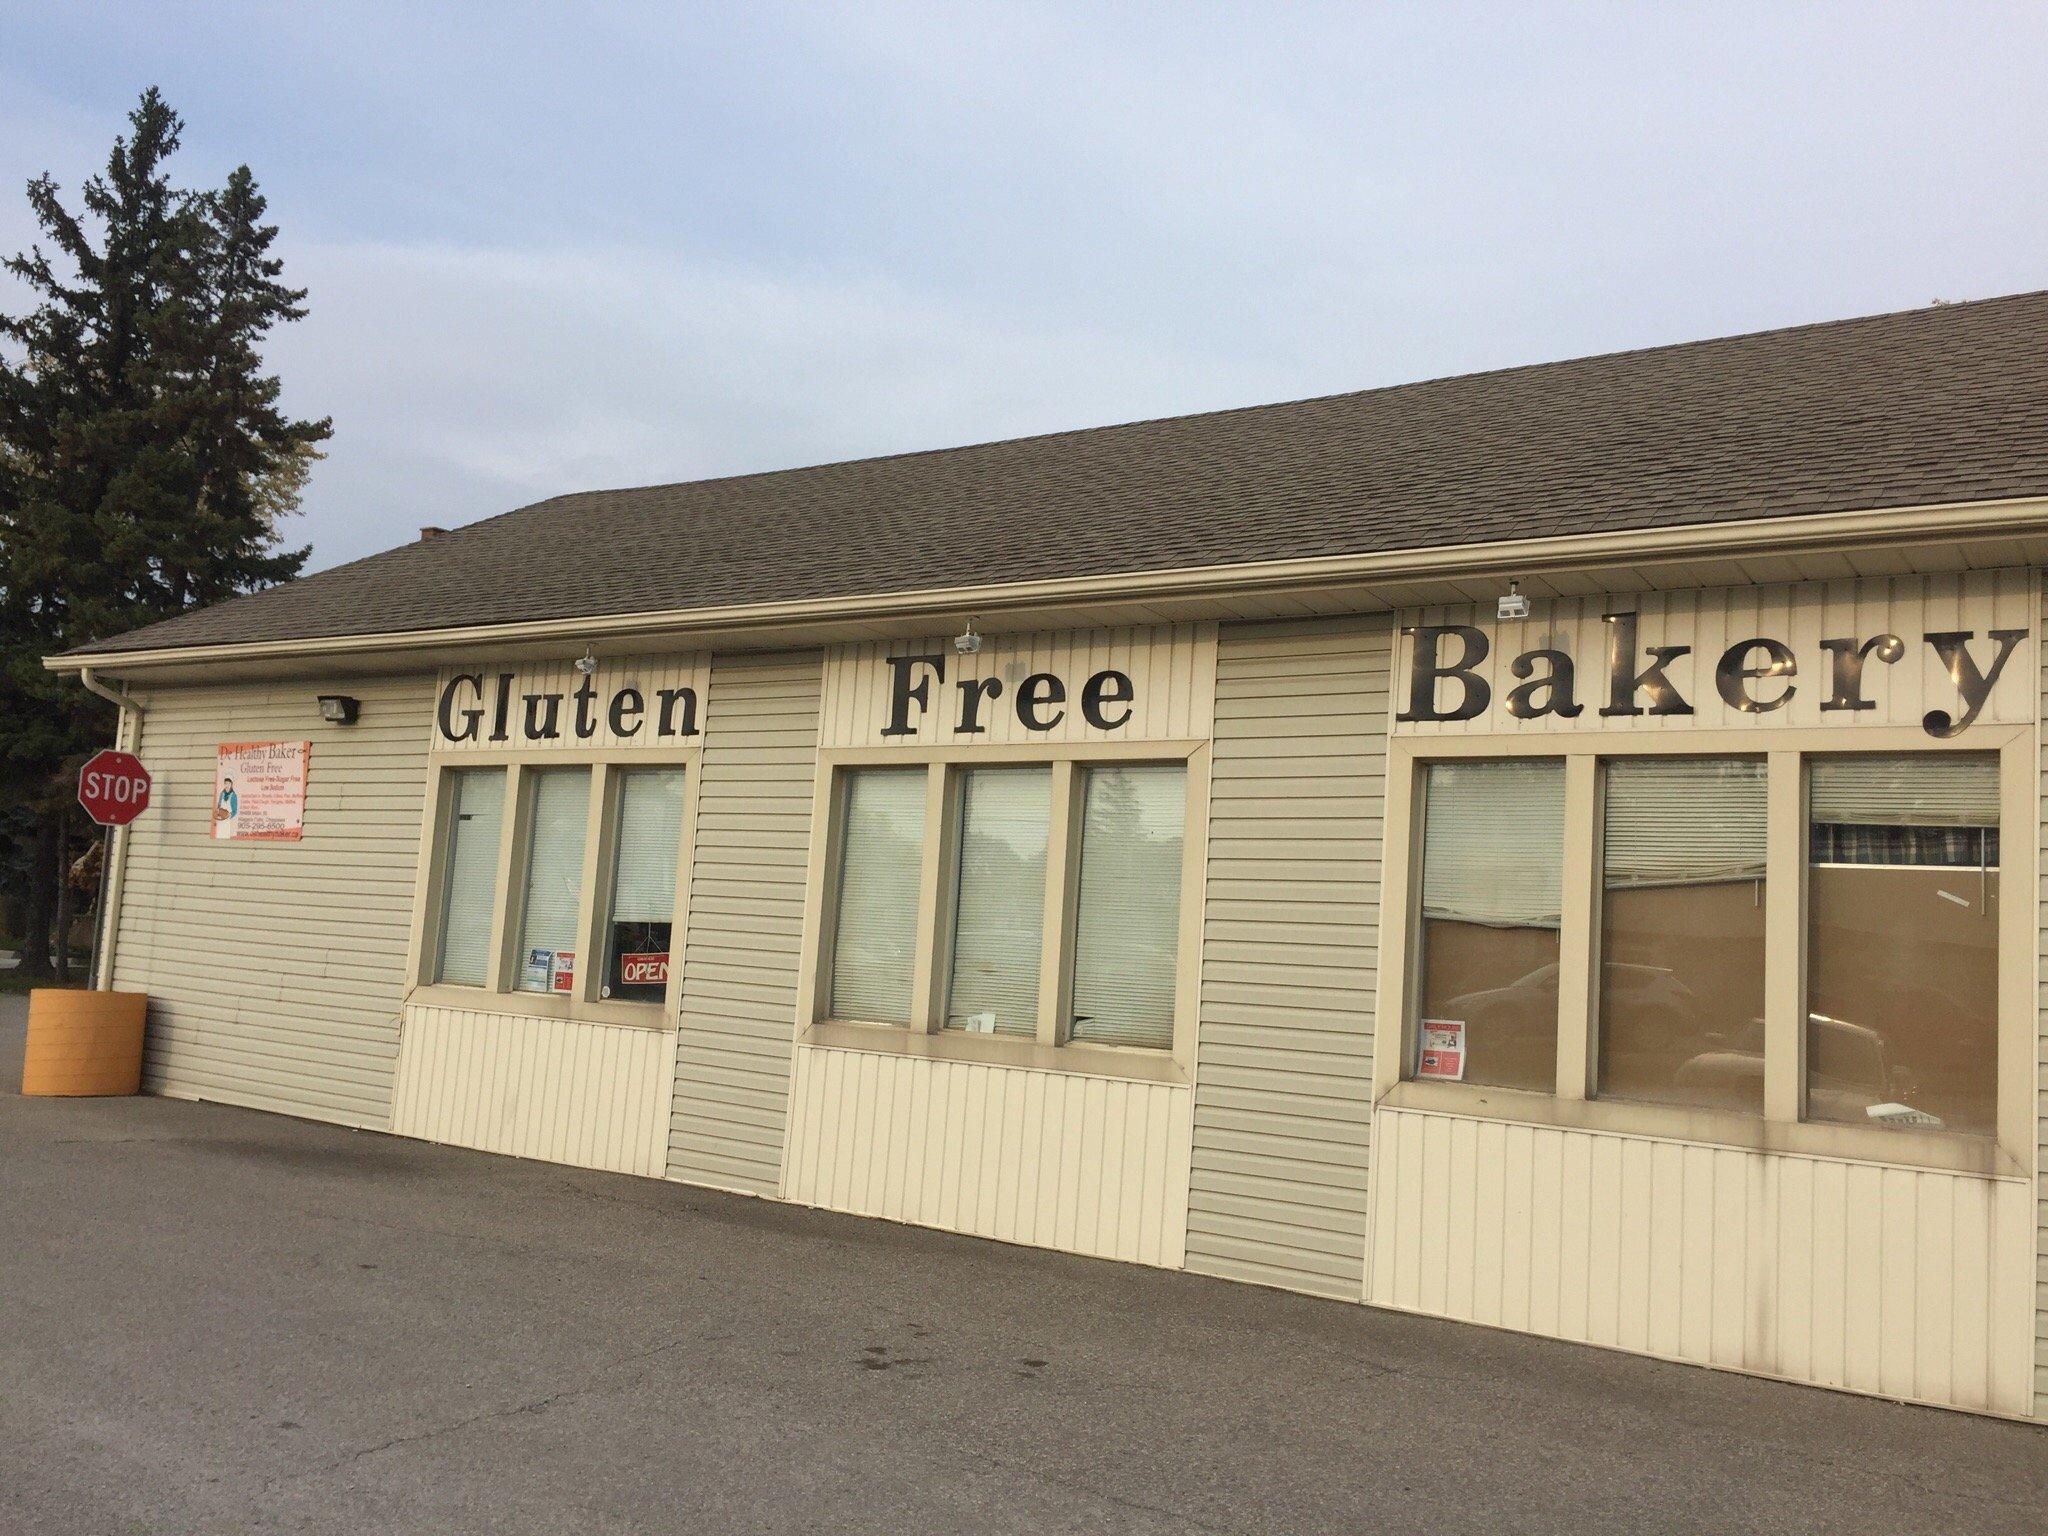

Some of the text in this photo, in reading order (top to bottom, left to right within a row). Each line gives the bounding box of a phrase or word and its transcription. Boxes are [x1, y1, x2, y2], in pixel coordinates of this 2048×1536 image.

[438, 611, 2030, 742] Gluten Free Bakery
[234, 744, 267, 764] Healthy
[268, 741, 296, 760] Baker
[240, 761, 283, 774] Gluten Free
[85, 771, 147, 804] STOP
